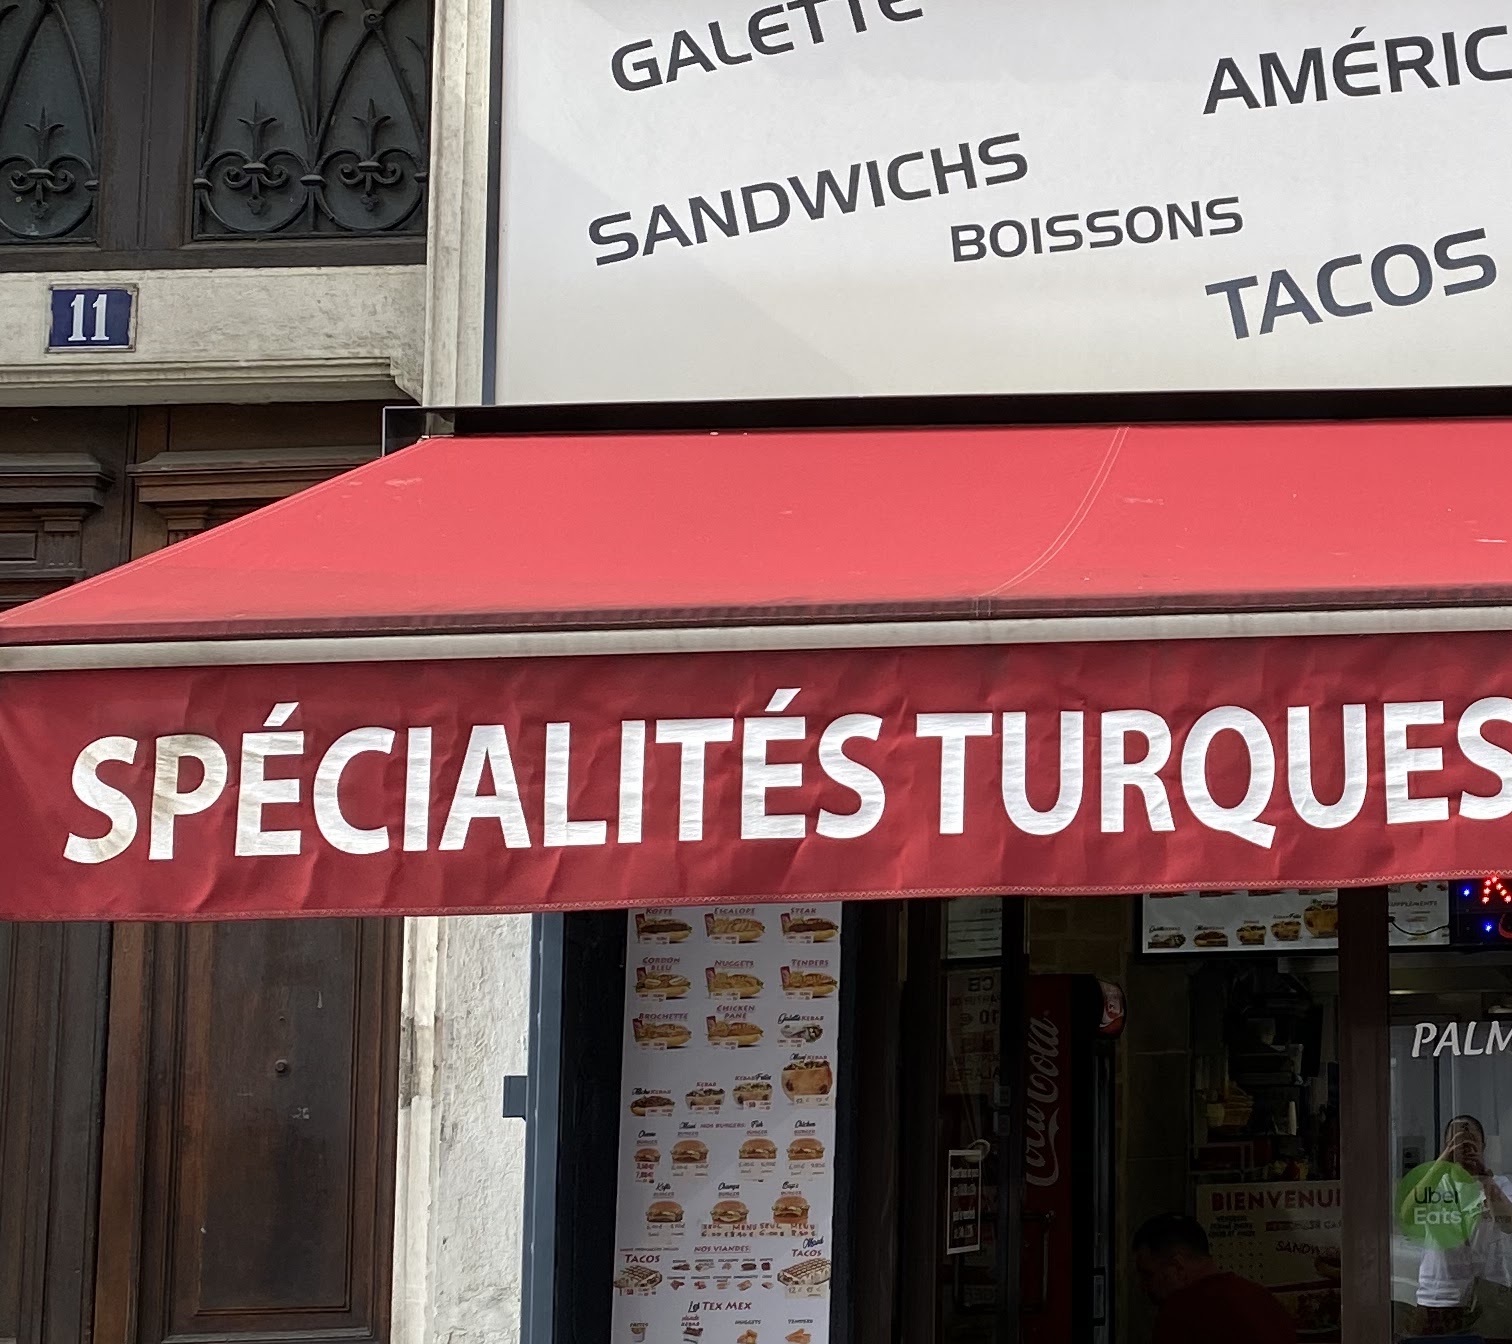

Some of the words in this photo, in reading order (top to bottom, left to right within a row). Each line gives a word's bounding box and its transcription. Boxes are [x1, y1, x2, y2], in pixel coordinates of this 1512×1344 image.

[588, 132, 1030, 266] SANDWICHS
[949, 196, 1244, 263] BOISSONS
[1205, 227, 1498, 341] TACOS
[67, 293, 110, 342] 11
[62, 687, 886, 865] SPÉCIALITÉS
[714, 907, 756, 915] ESCALOPE
[714, 959, 755, 968] NUGGETS
[791, 959, 830, 967] TENDERS
[717, 1004, 756, 1012] CHICKEN
[638, 1012, 688, 1020] BROCHETTE
[1413, 1207, 1462, 1225] Eats
[791, 1249, 822, 1257] TACOS
[625, 1254, 661, 1263] TACOS
[703, 1302, 723, 1311] TEX
[724, 1301, 752, 1311] MEX
